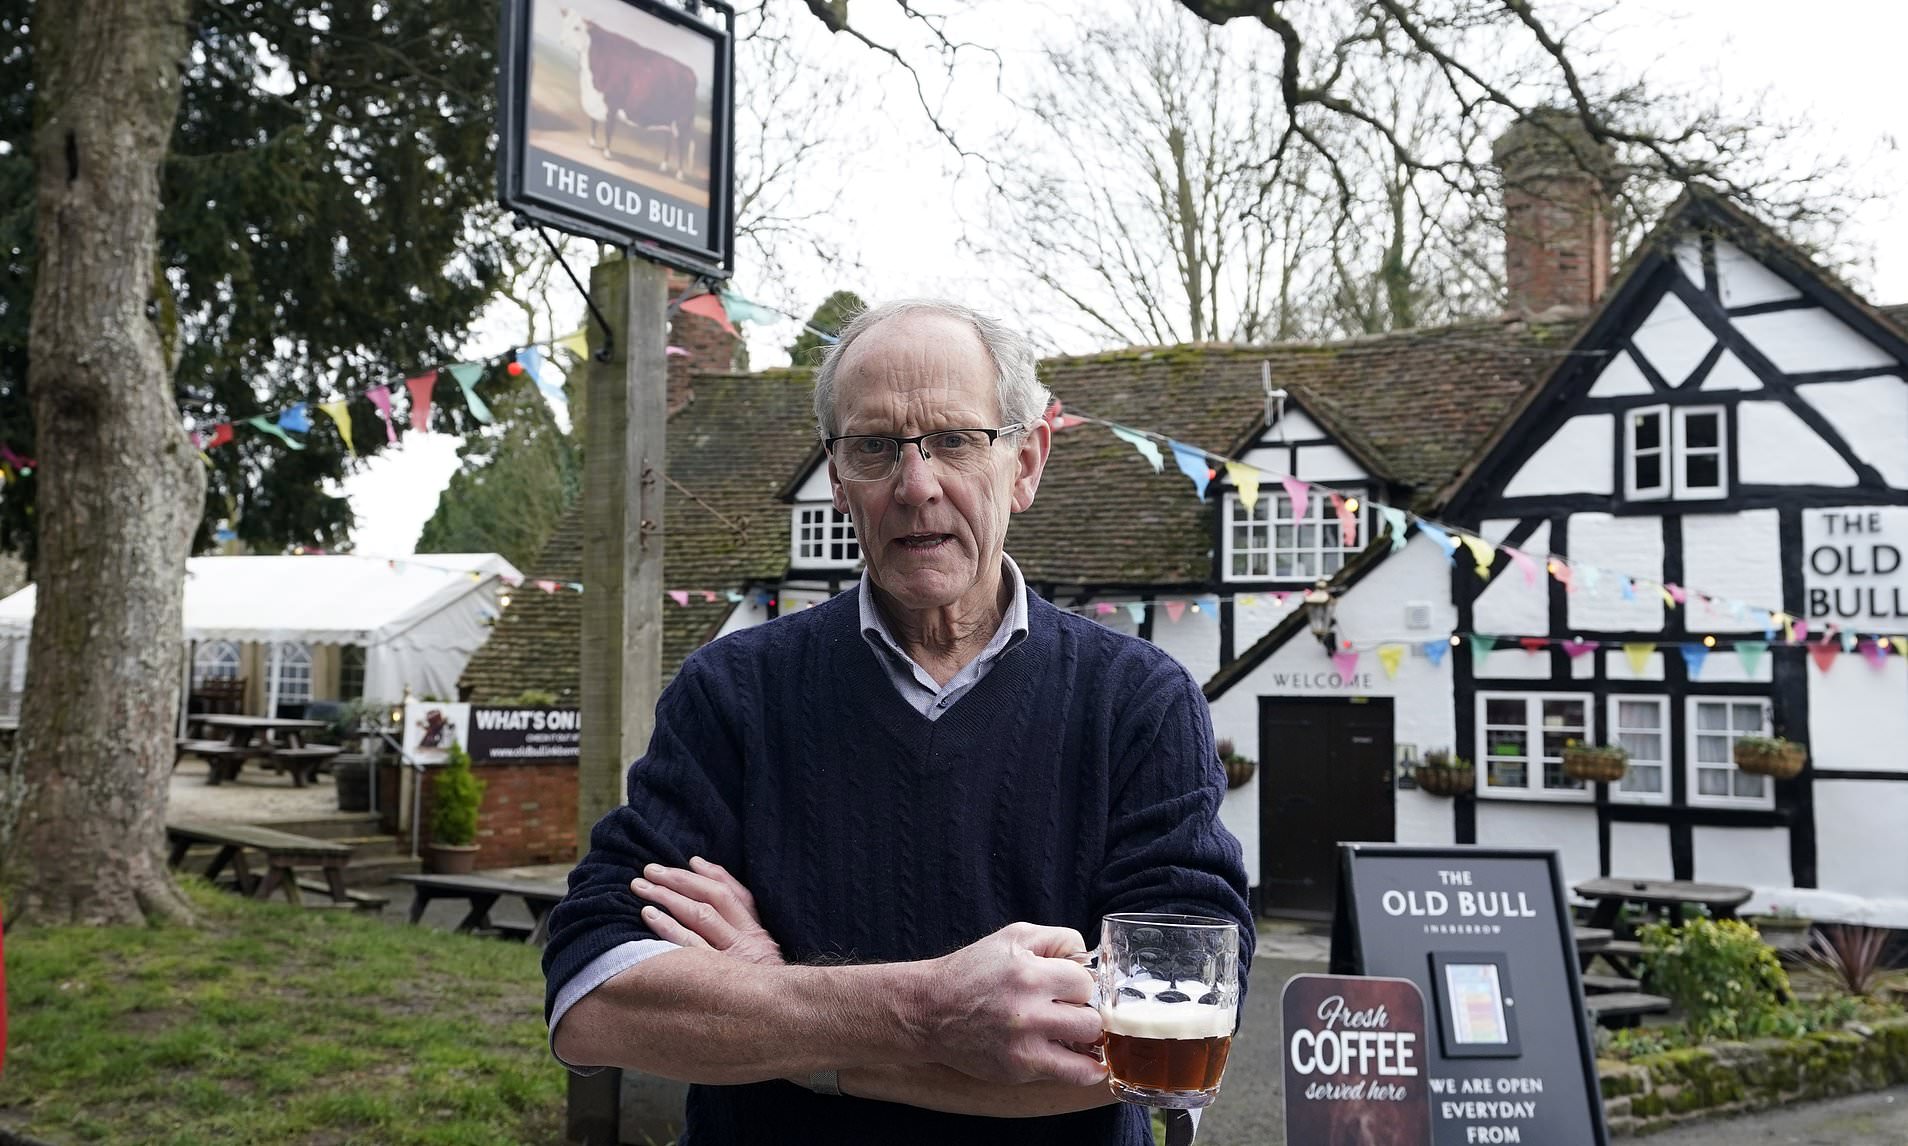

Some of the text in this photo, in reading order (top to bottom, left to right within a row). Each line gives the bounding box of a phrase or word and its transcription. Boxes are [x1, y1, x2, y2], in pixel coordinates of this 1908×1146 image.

[542, 161, 698, 236] THE OLD BULL
[1821, 513, 1881, 535] THE
[1810, 545, 1902, 576] OLD
[1810, 587, 1908, 618] BULL
[475, 710, 545, 730] WHAT'S
[547, 710, 574, 730] ON
[1438, 870, 1473, 886] THE
[1382, 890, 1537, 918] OLD BULL
[1317, 995, 1390, 1030] Fresh
[1291, 1028, 1419, 1076] COFFEE
[1305, 1080, 1407, 1101] served here
[1429, 1078, 1544, 1094] WE ARE OPEN
[1441, 1102, 1537, 1120] EVERYDAY
[1466, 1126, 1521, 1144] FROM
